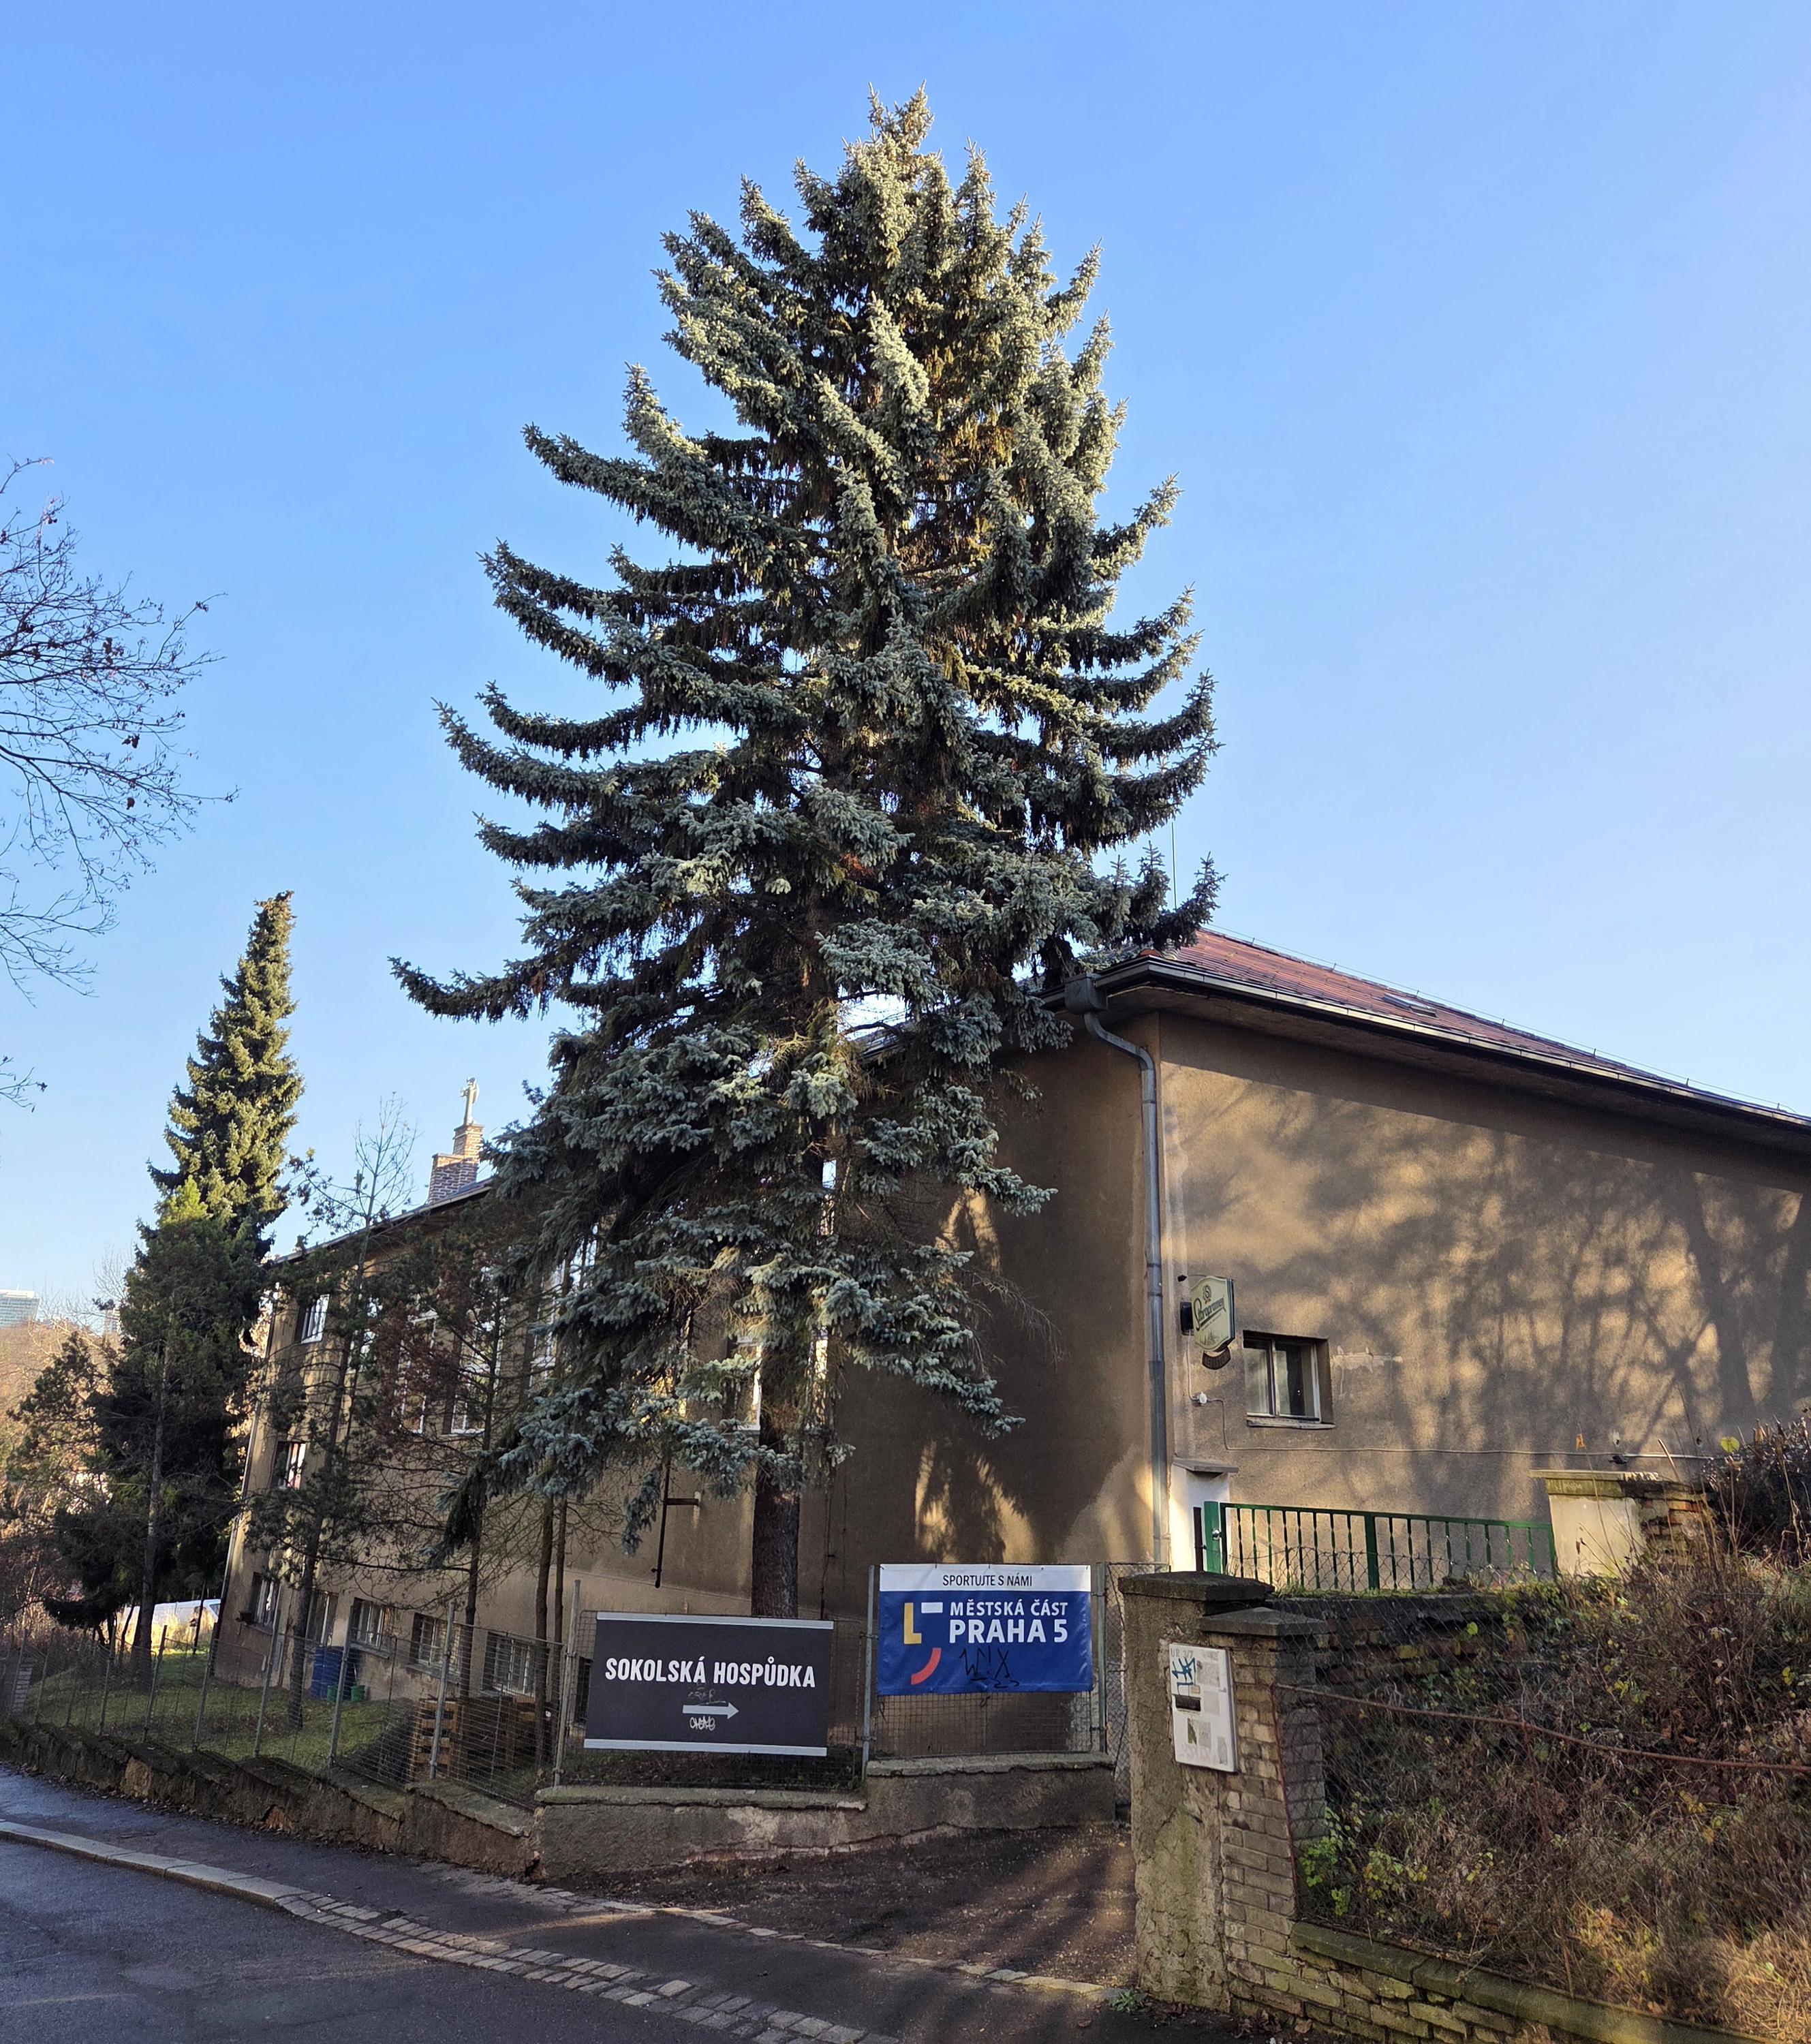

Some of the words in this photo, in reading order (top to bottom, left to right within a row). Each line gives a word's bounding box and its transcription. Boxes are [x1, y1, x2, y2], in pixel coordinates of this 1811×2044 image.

[942, 1575, 996, 1586] SPORTUJTE
[998, 1575, 1004, 1586] S
[1006, 1572, 1033, 1587] NÁMI
[950, 1599, 1025, 1616] MĚSTSKÁ
[1030, 1599, 1068, 1616] ČÁST
[949, 1619, 1047, 1643] PRAHA
[1053, 1619, 1068, 1643] 5
[605, 1656, 706, 1683] SOKOLSKÁ
[713, 1656, 816, 1688] HOSPŮDKA
